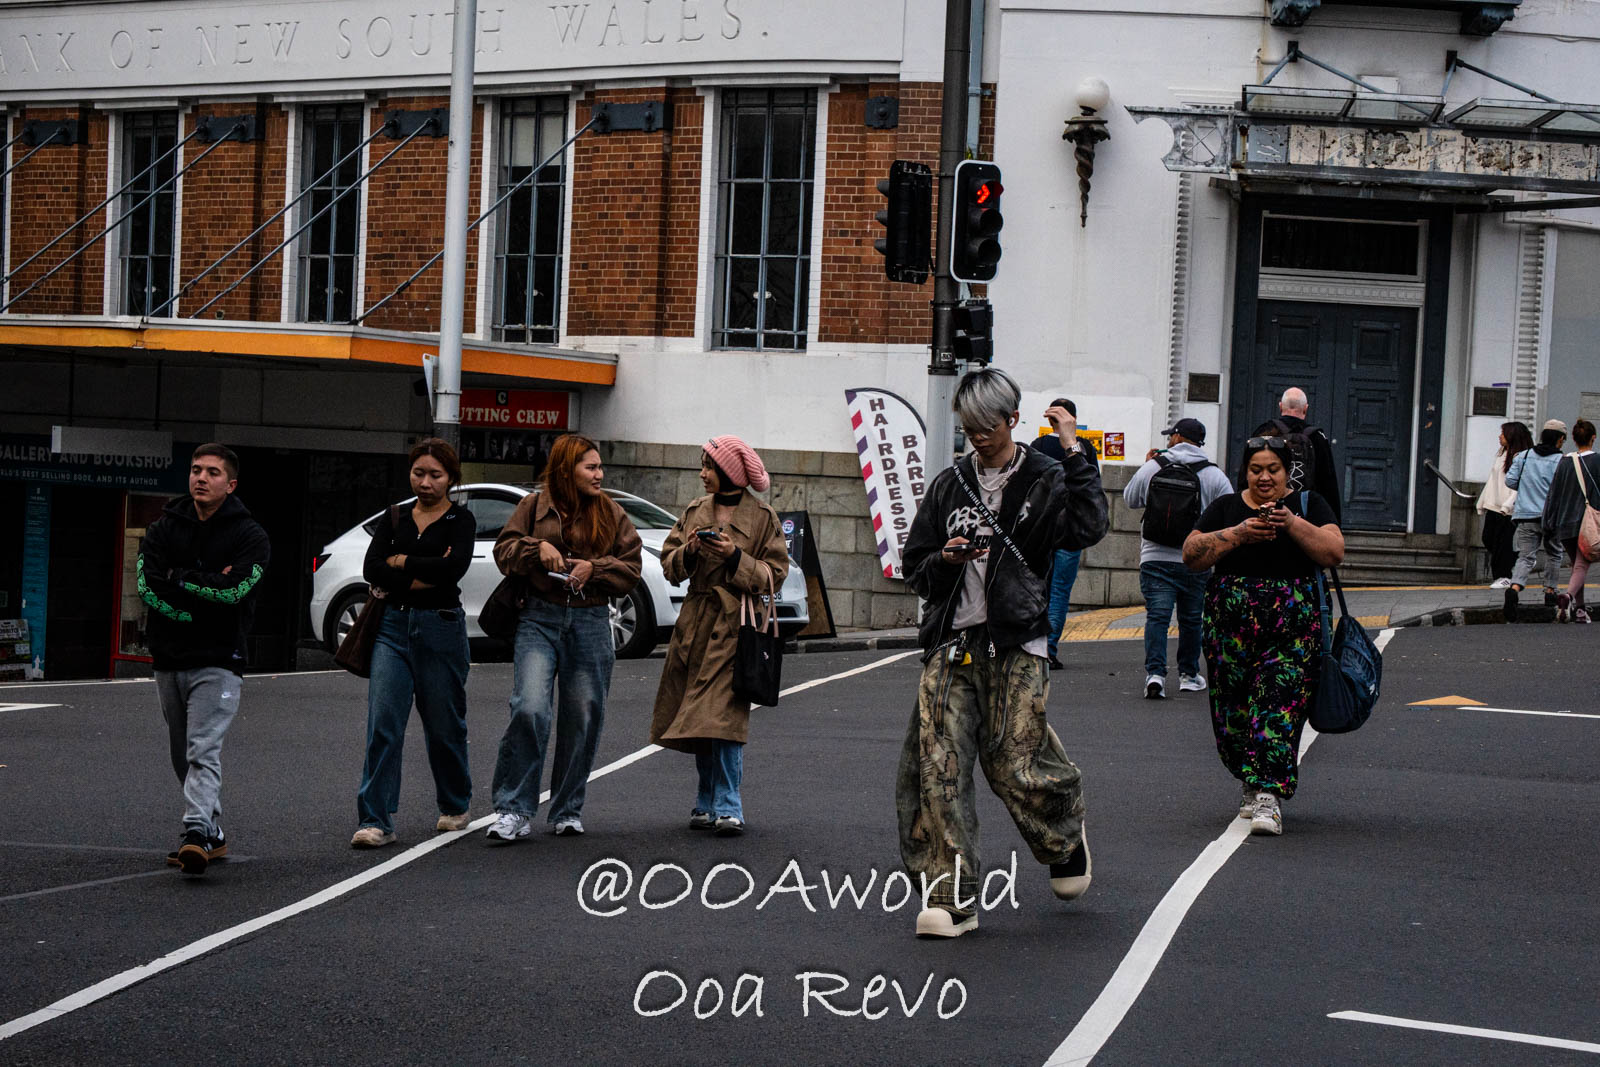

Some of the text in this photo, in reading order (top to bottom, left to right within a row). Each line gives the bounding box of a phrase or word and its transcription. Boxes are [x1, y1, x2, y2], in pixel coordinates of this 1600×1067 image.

[110, 28, 163, 69] OF
[196, 21, 302, 67] NEW
[336, 8, 504, 60] SOUH
[547, 0, 769, 48] WALES.
[498, 392, 506, 404] C
[516, 409, 560, 425] CREW
[59, 452, 88, 465] AND
[94, 454, 173, 470] BOOKSHOP
[22, 470, 39, 478] BEST
[41, 471, 71, 480] SELLING
[96, 474, 112, 482] AND
[115, 476, 127, 484] ITS
[129, 477, 158, 486] AUTHOR
[869, 397, 908, 560] HAIRDRESSE
[986, 515, 995, 524] THE
[992, 524, 1003, 535] PAST
[1003, 536, 1012, 545] THE
